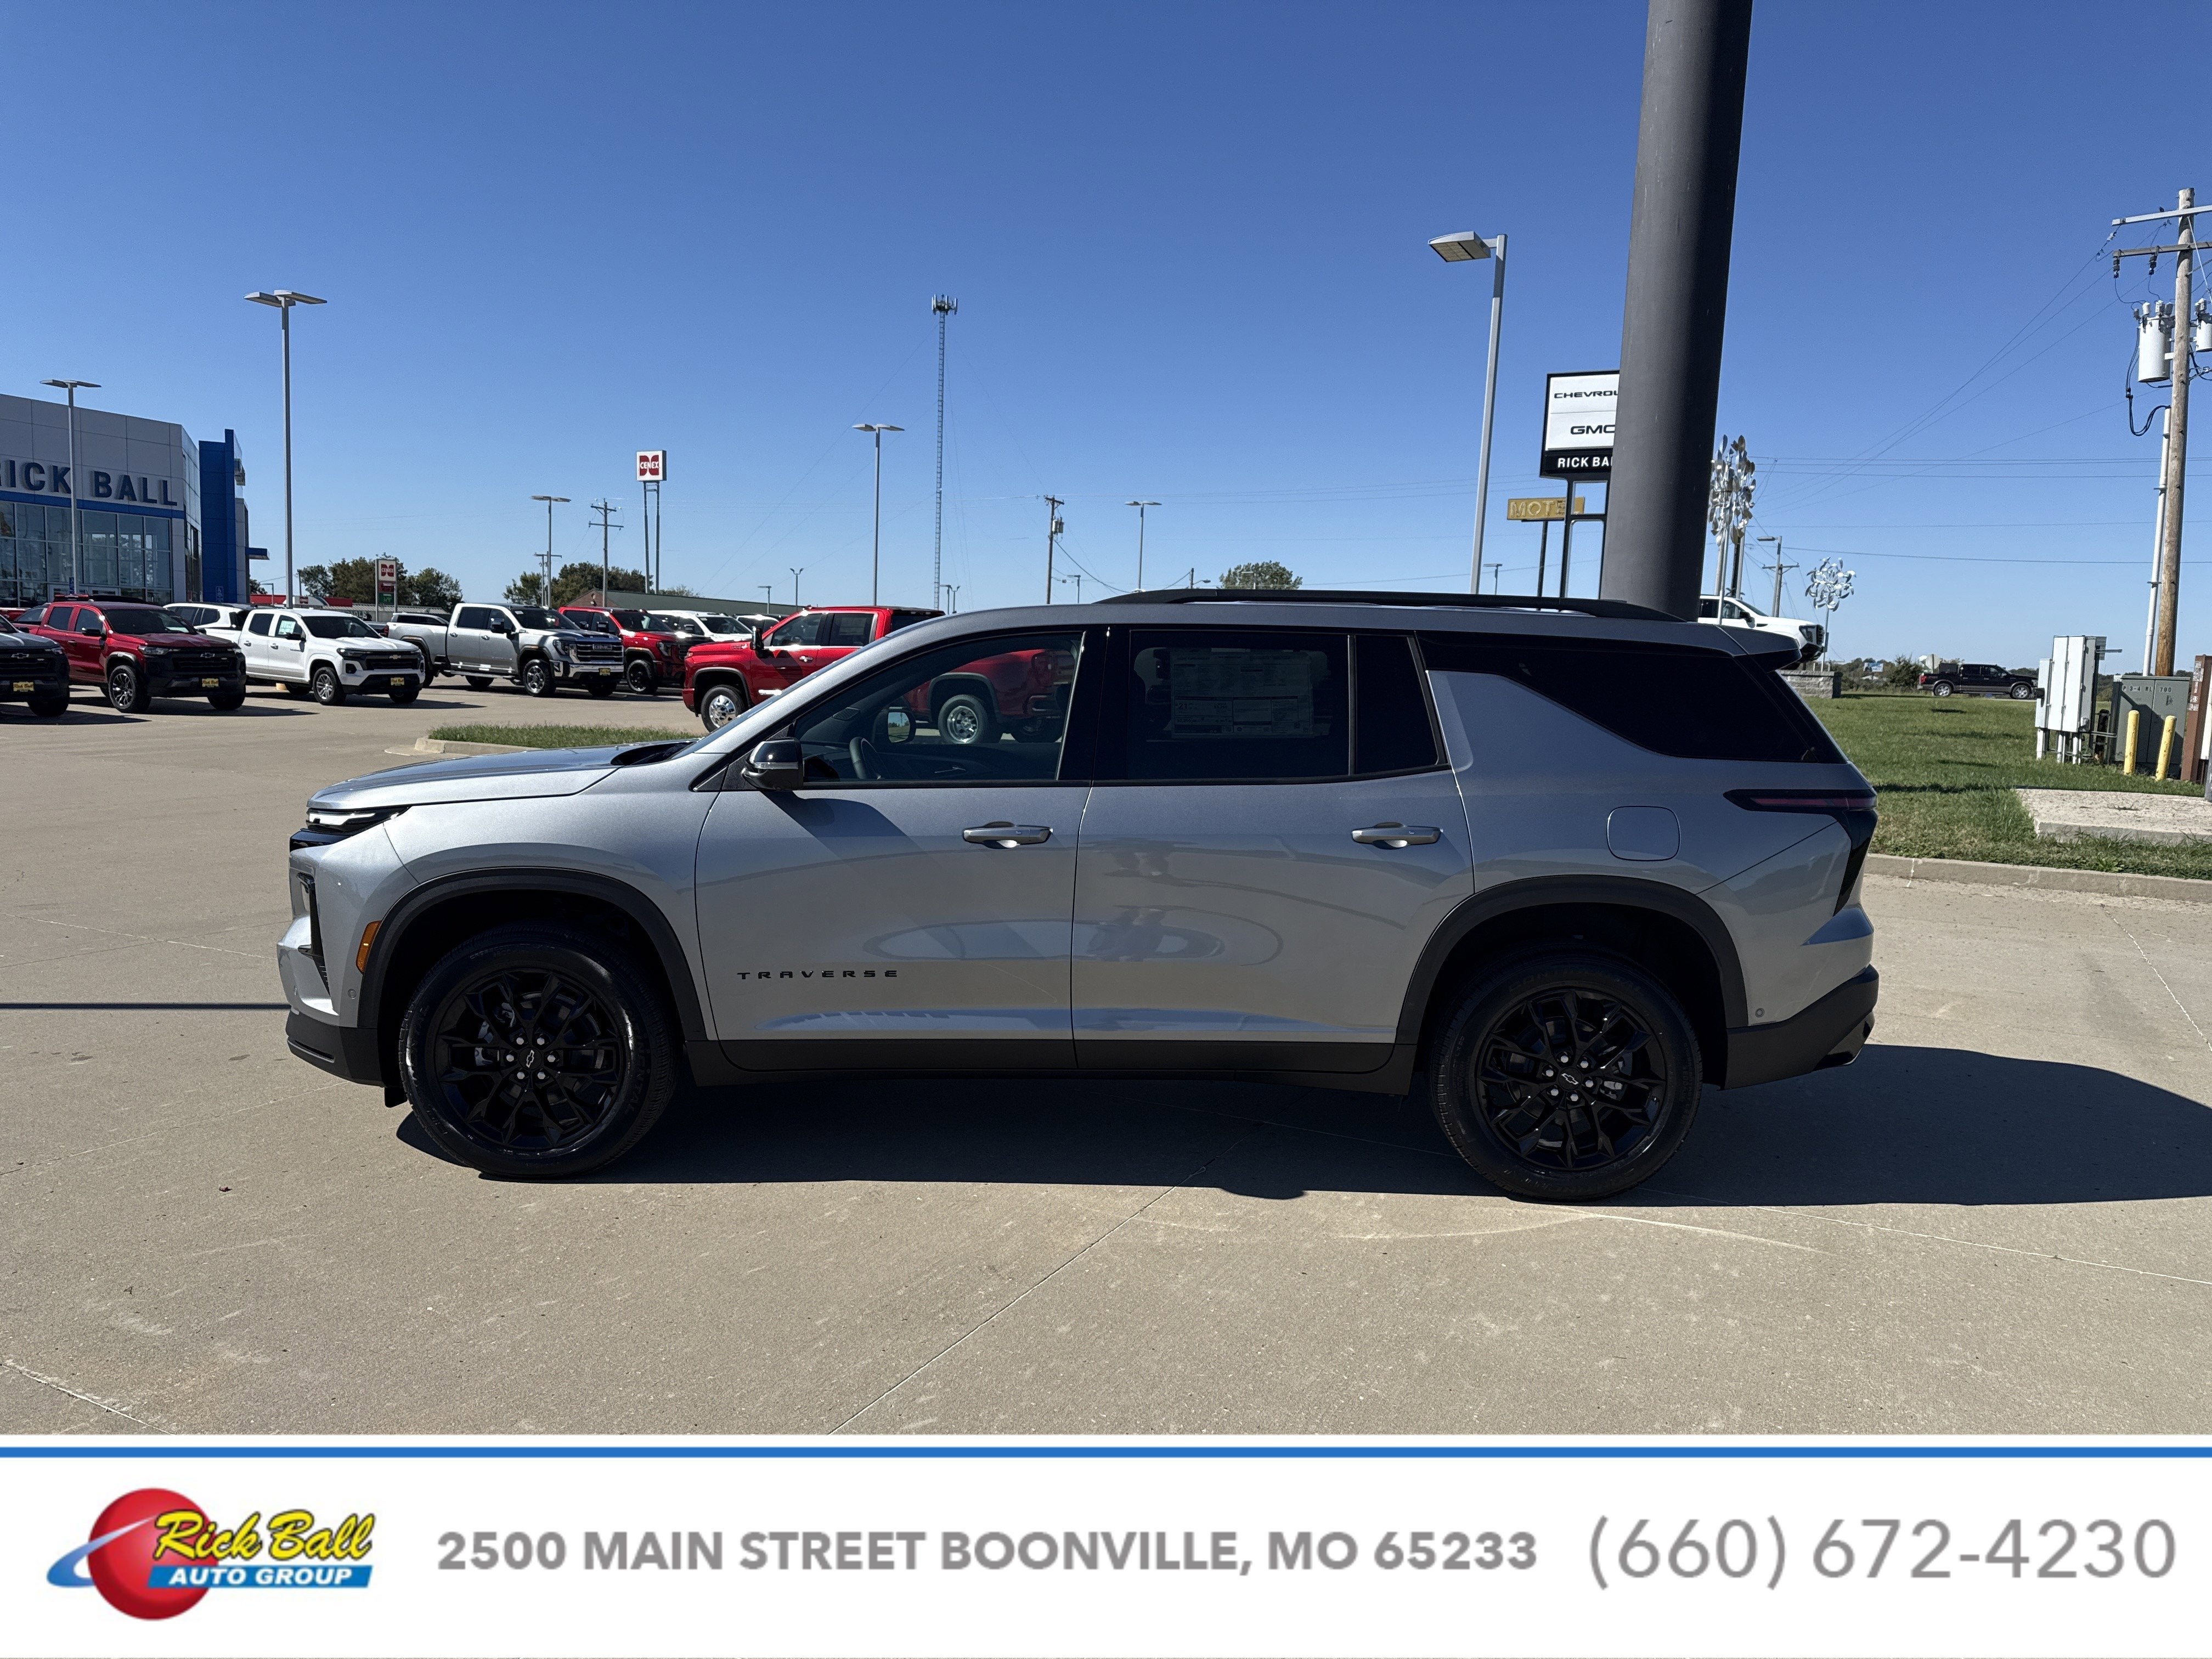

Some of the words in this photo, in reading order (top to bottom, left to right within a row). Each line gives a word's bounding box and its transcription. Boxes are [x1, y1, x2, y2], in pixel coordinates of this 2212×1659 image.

[1570, 424, 1616, 435] GMC
[640, 461, 659, 470] CENEX
[1558, 456, 1589, 468] RICK
[1592, 456, 1613, 467] BA
[0, 459, 71, 494] ICK
[90, 470, 178, 506] BALL
[1510, 500, 1580, 517] MOTE
[737, 969, 898, 980] TRAVERSE
